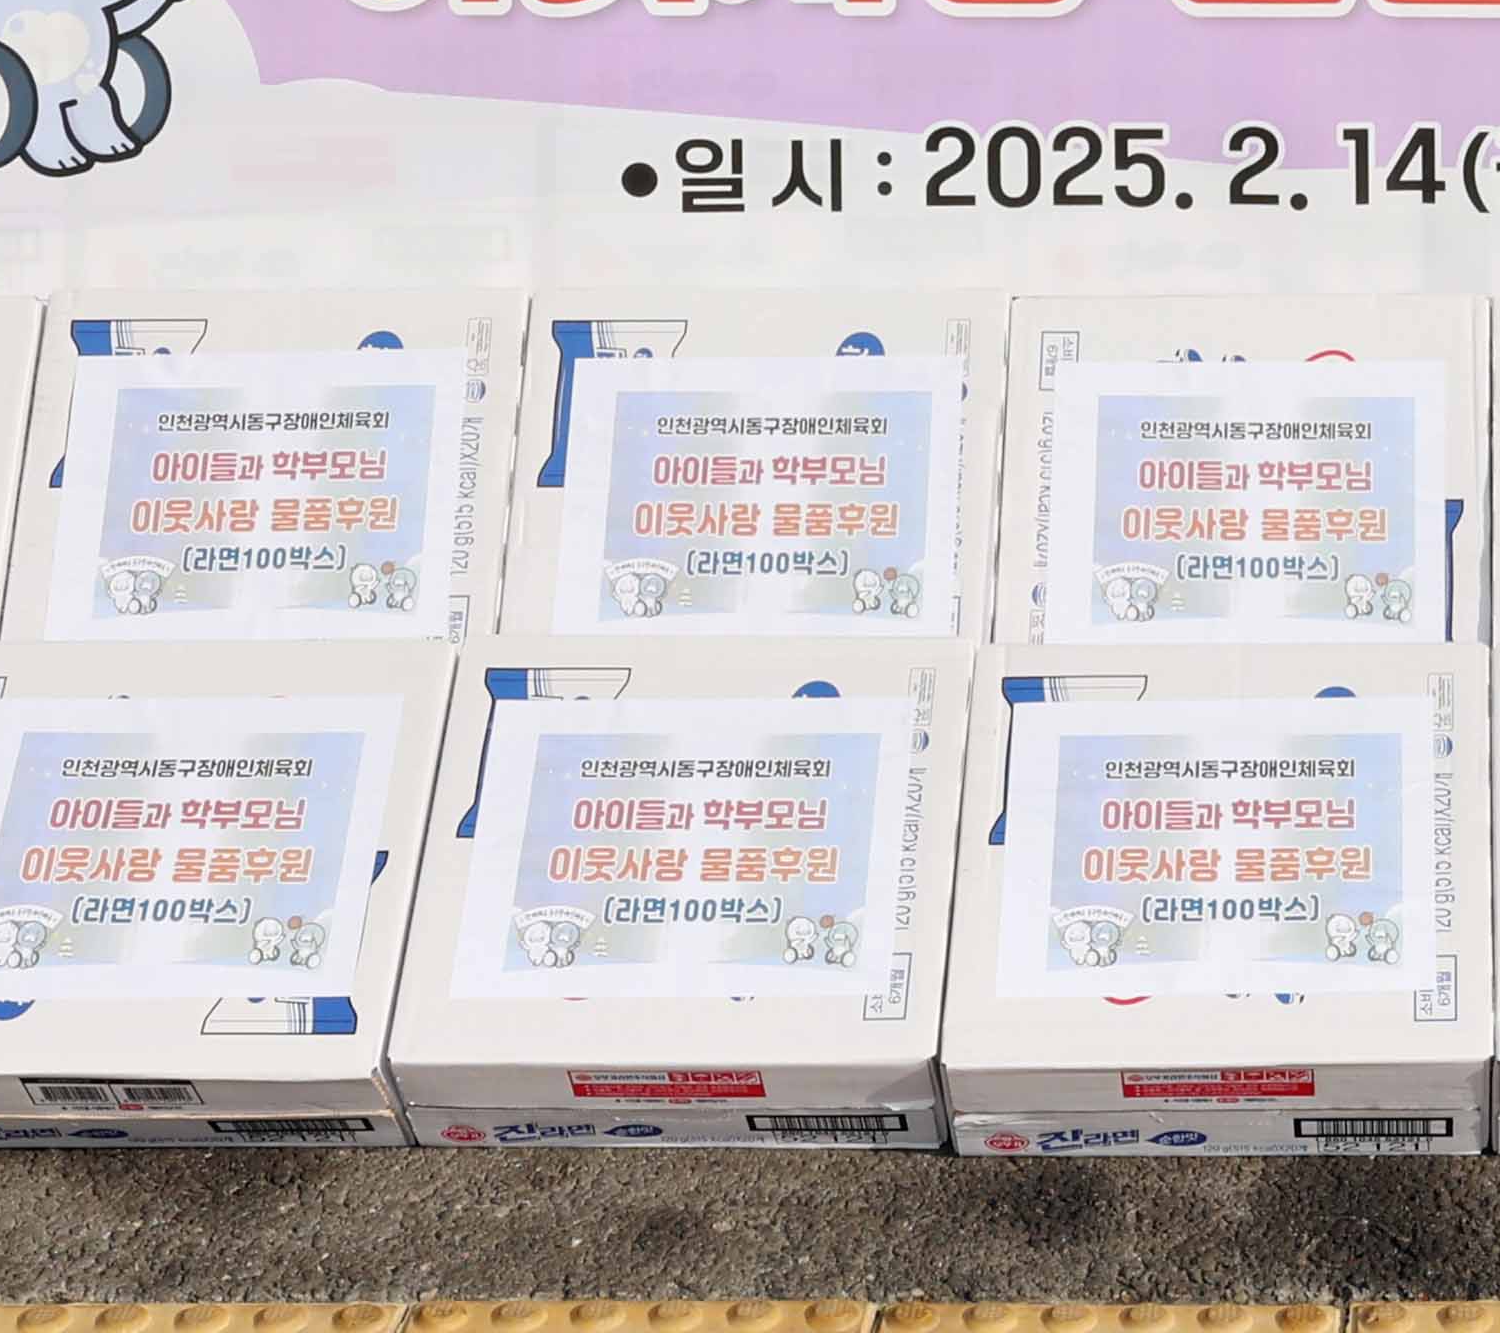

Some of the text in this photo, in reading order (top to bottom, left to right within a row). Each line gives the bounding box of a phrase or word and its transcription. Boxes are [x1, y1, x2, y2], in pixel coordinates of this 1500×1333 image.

[922, 126, 1194, 216] 2025.
[1226, 126, 1310, 216] 2.
[1141, 422, 1371, 440] 인천광역시동구장애인체육회
[1140, 461, 1371, 491] 아이들과 학부모님
[1124, 508, 1385, 541] 이웃사랑 물품후원
[62, 759, 312, 777] 인천광역시동구장애인체육회
[50, 799, 305, 829] 아이들과 학부모님
[20, 848, 312, 885] 이웃사랑 물품후원
